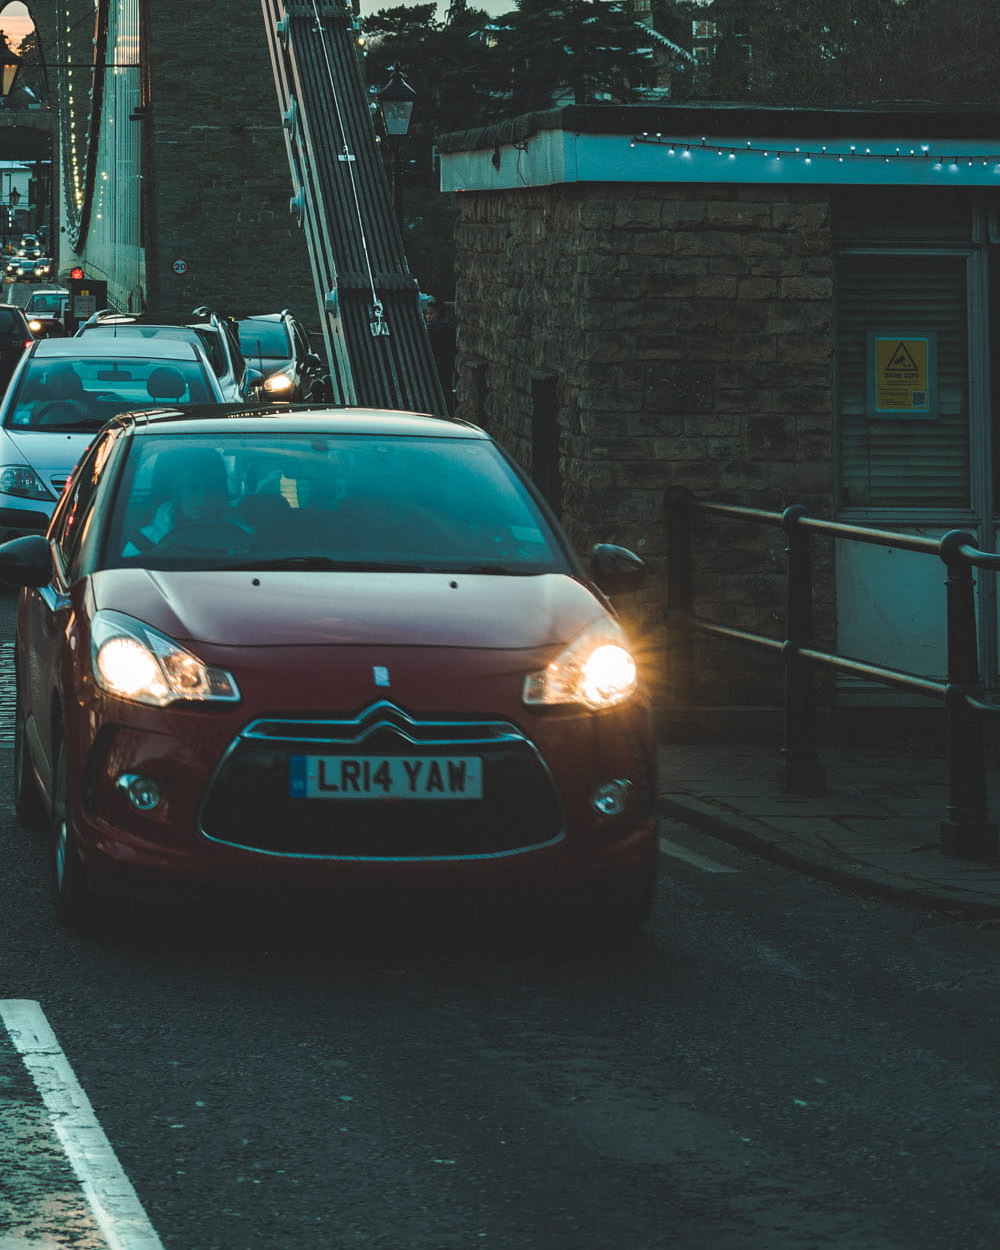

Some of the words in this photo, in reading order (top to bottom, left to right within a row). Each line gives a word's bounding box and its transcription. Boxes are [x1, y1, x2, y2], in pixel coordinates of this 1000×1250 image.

[174, 262, 186, 271] 20
[317, 759, 393, 793] LR14
[402, 760, 467, 793] YAW
